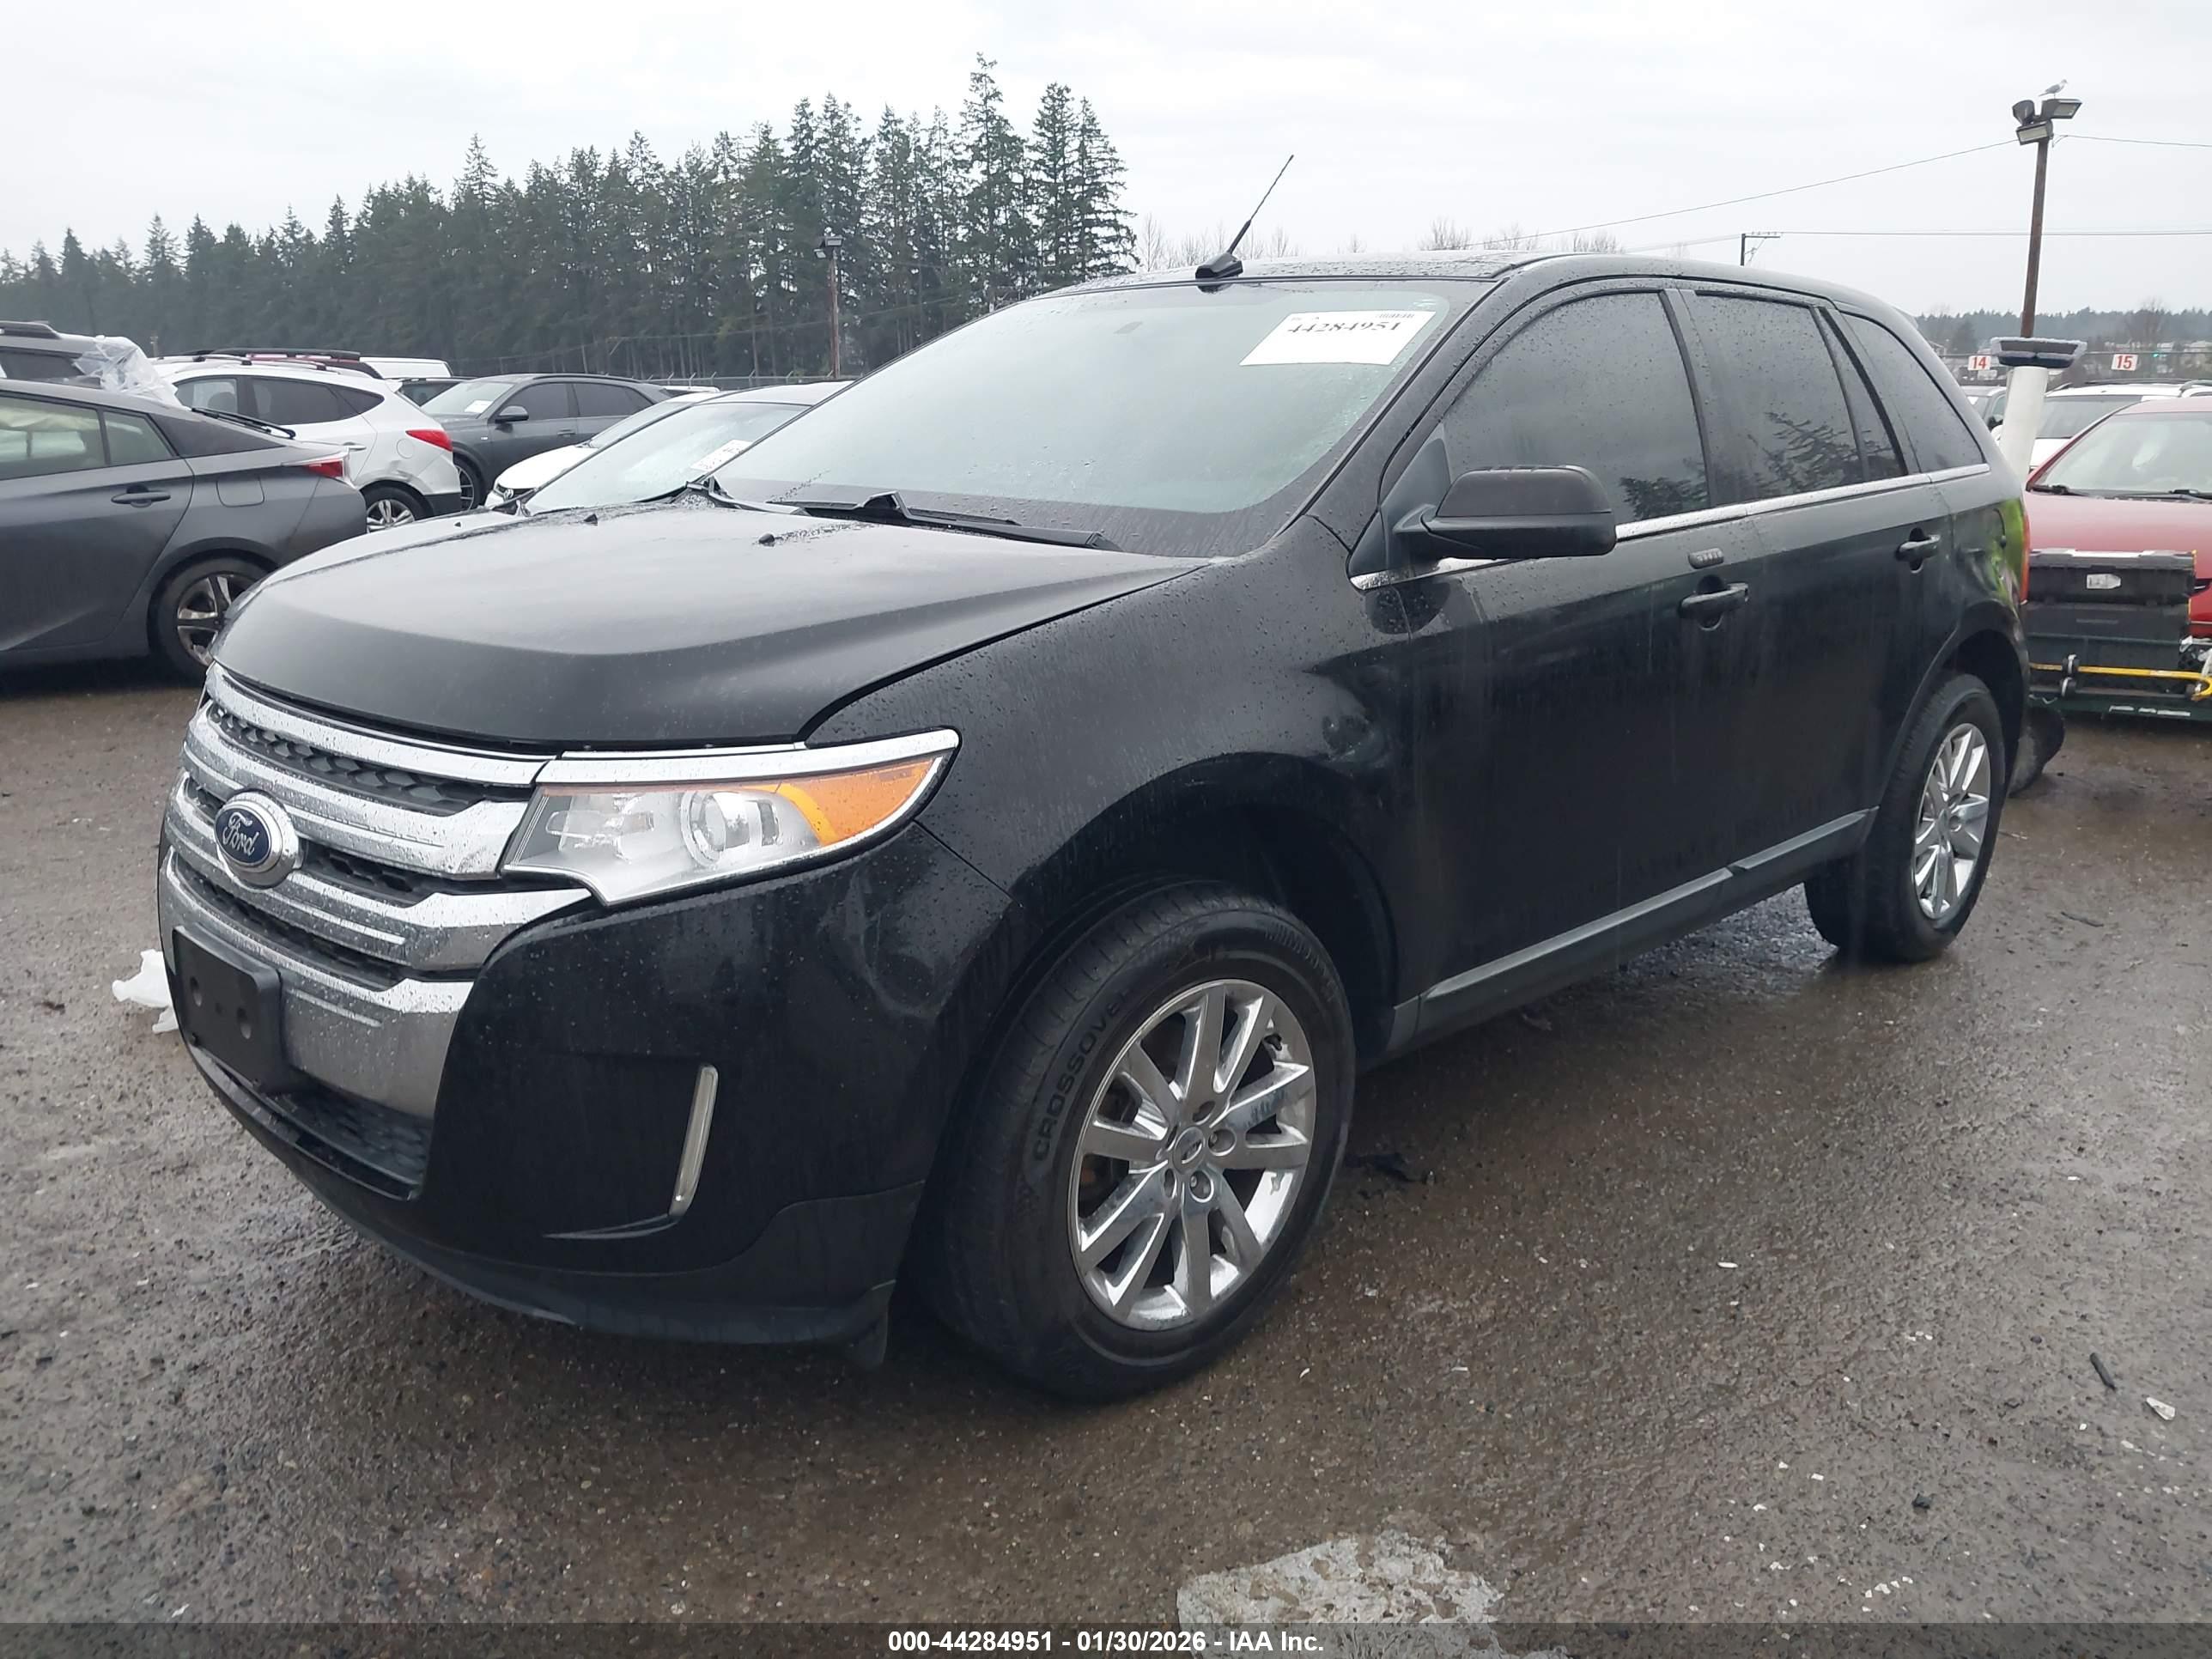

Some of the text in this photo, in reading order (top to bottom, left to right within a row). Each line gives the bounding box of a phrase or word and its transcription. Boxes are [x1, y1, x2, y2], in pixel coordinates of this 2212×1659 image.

[1288, 321, 1401, 333] 44284951
[1971, 356, 1988, 370] 14
[2116, 355, 2133, 370] 15
[222, 812, 259, 856] Ford
